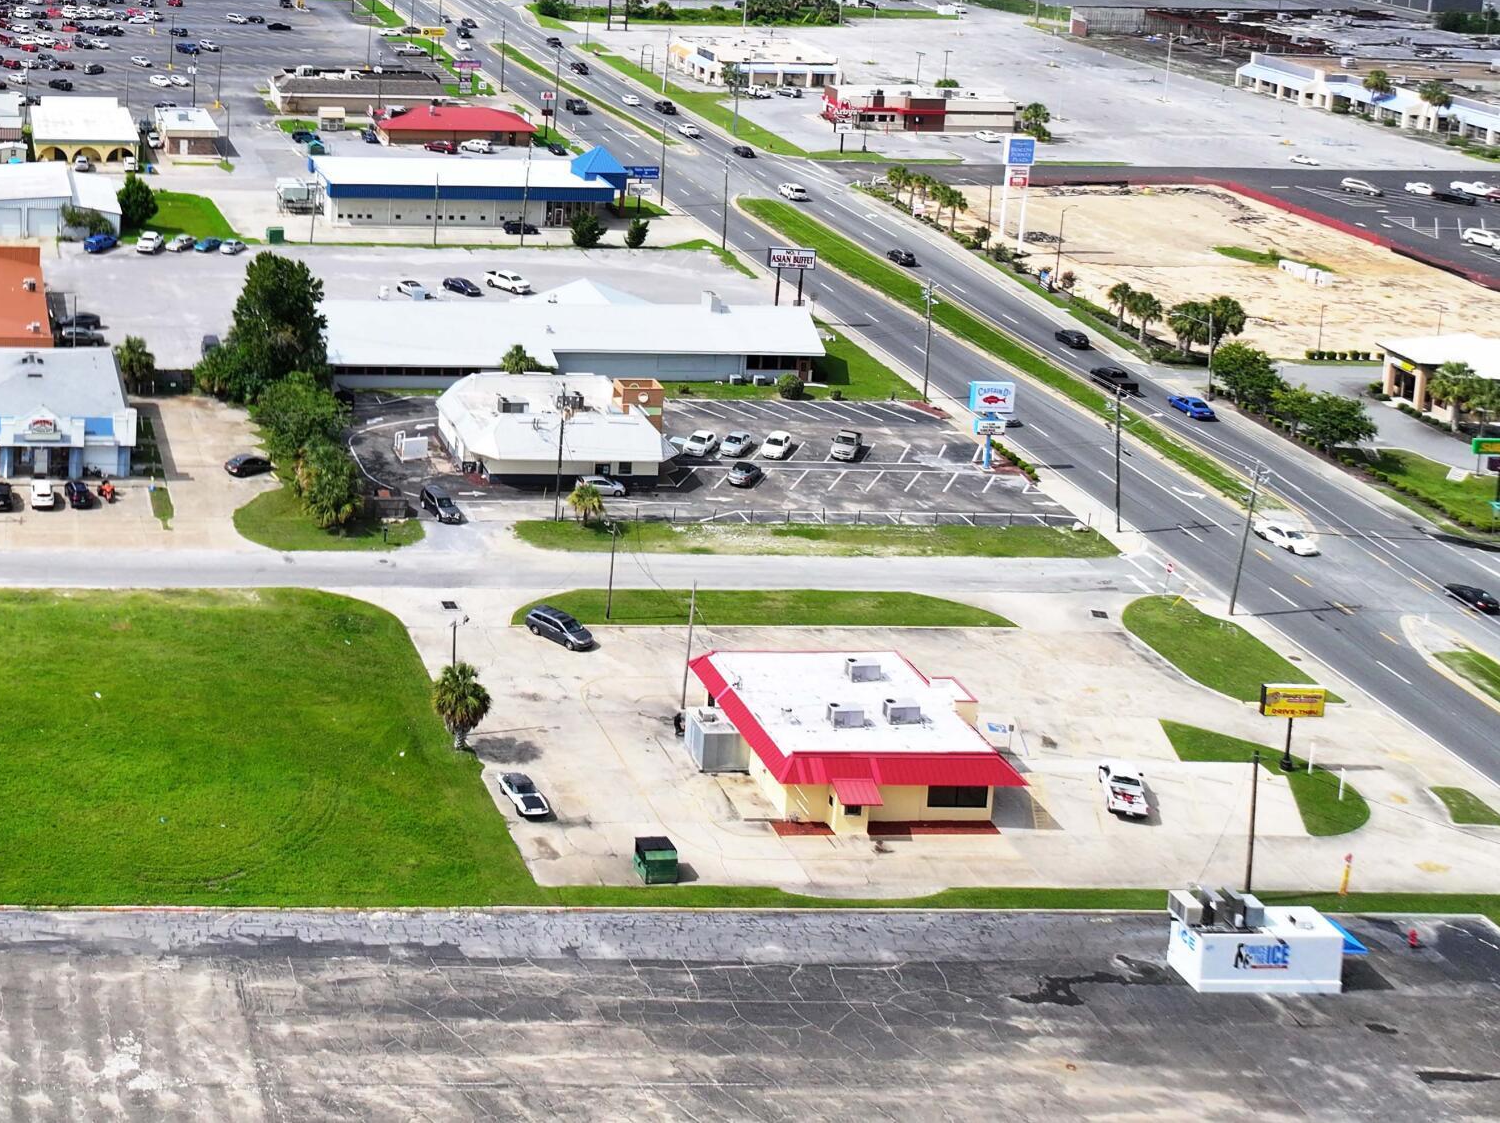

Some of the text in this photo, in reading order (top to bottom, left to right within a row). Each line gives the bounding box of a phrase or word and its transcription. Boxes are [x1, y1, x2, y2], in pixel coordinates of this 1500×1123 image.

[772, 254, 814, 264] ASIAN BUFFET
[1267, 945, 1290, 964] ICE
